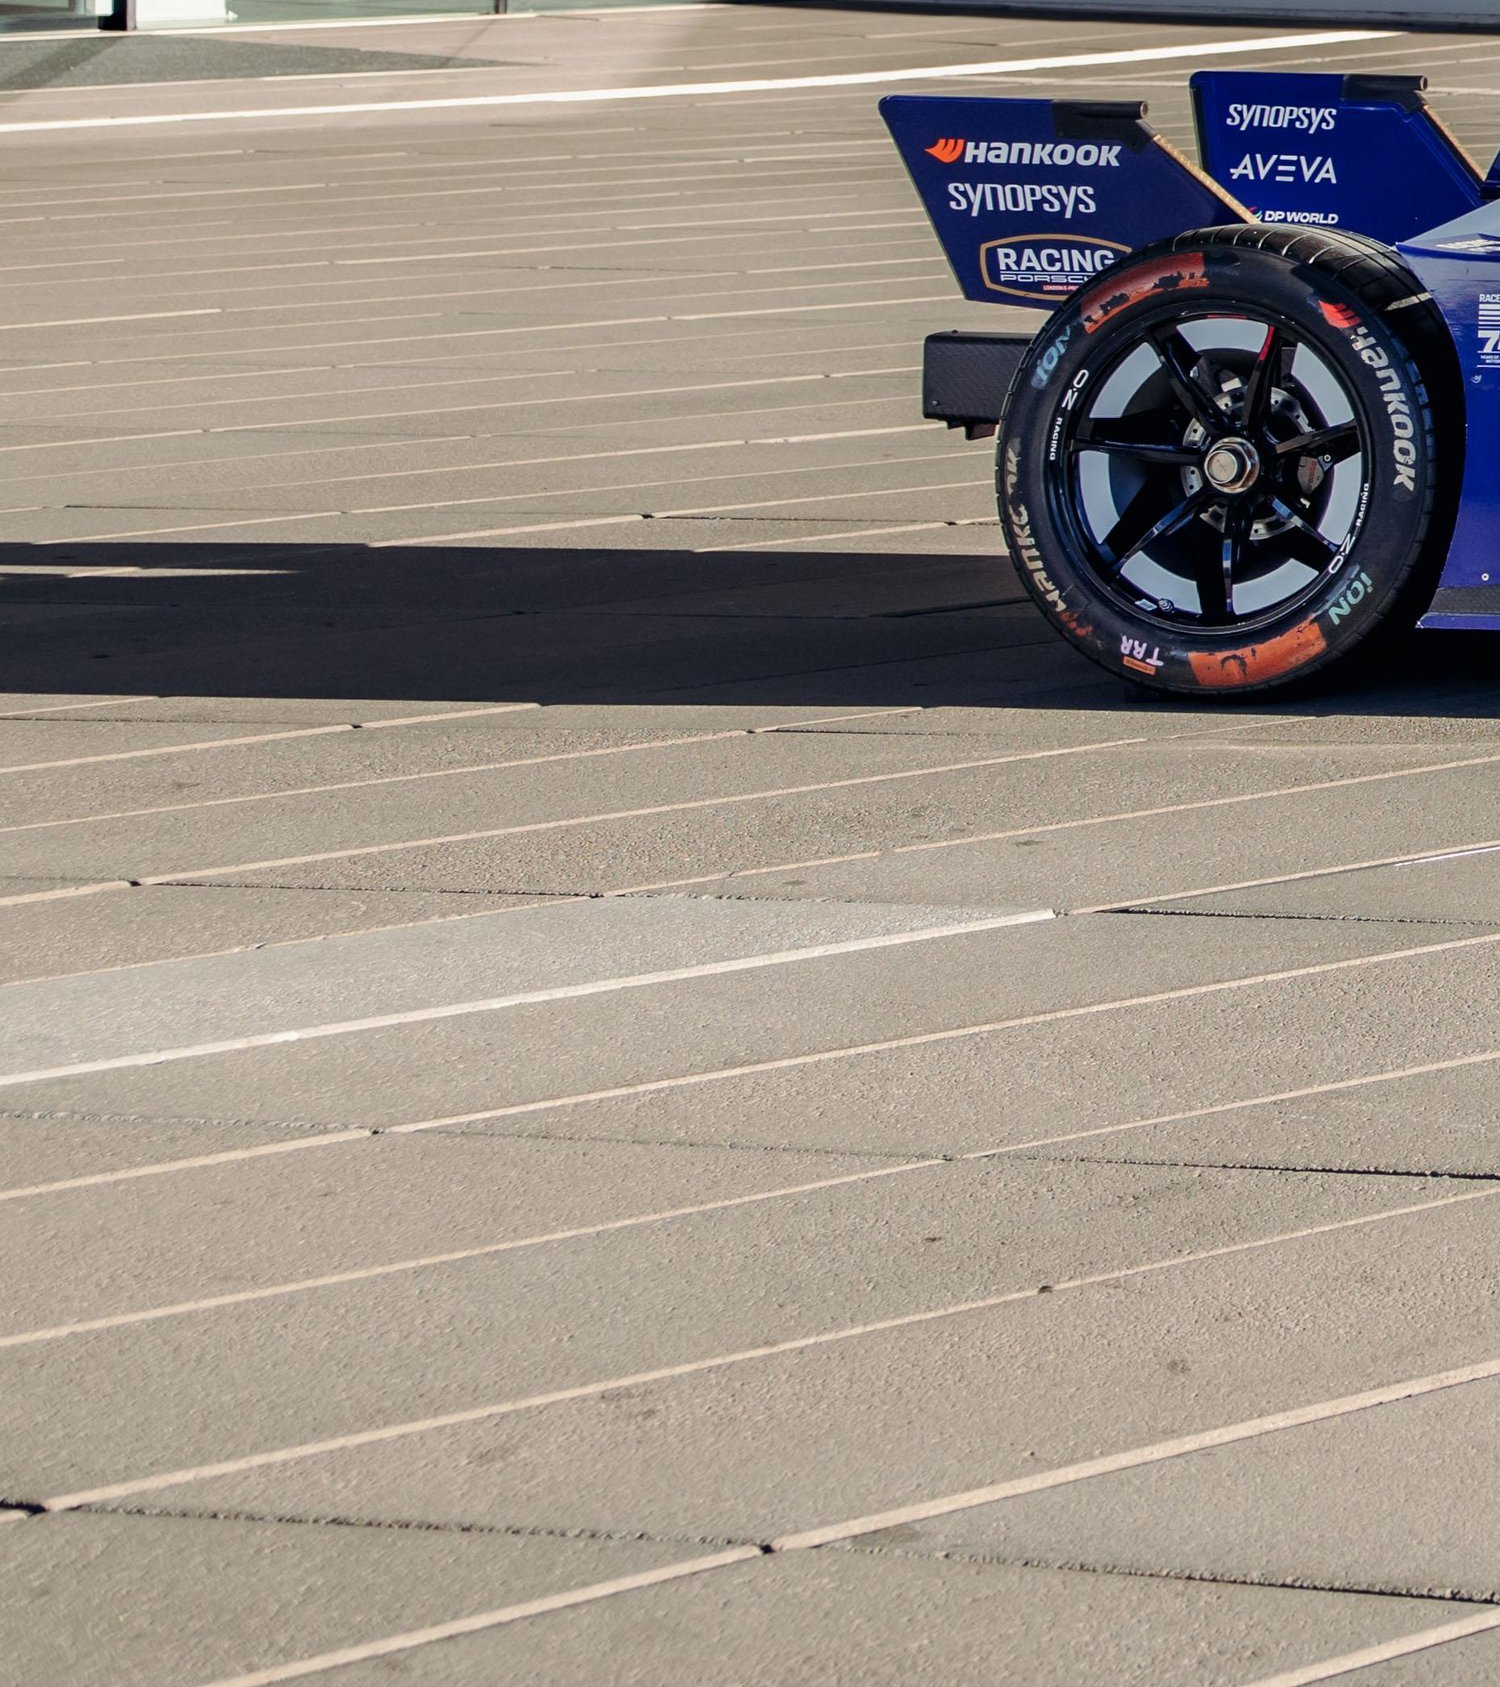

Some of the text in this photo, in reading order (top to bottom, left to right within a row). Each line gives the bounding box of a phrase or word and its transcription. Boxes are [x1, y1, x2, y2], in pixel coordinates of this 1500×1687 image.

[1226, 104, 1337, 134] SYNOPSYS
[1229, 153, 1338, 185] AVEVA
[948, 182, 1097, 219] SYNOPSYS
[1264, 210, 1339, 224] DP WORLD
[997, 248, 1116, 272] RACING
[1050, 417, 1063, 461] RACING
[1356, 482, 1370, 527] RACING
